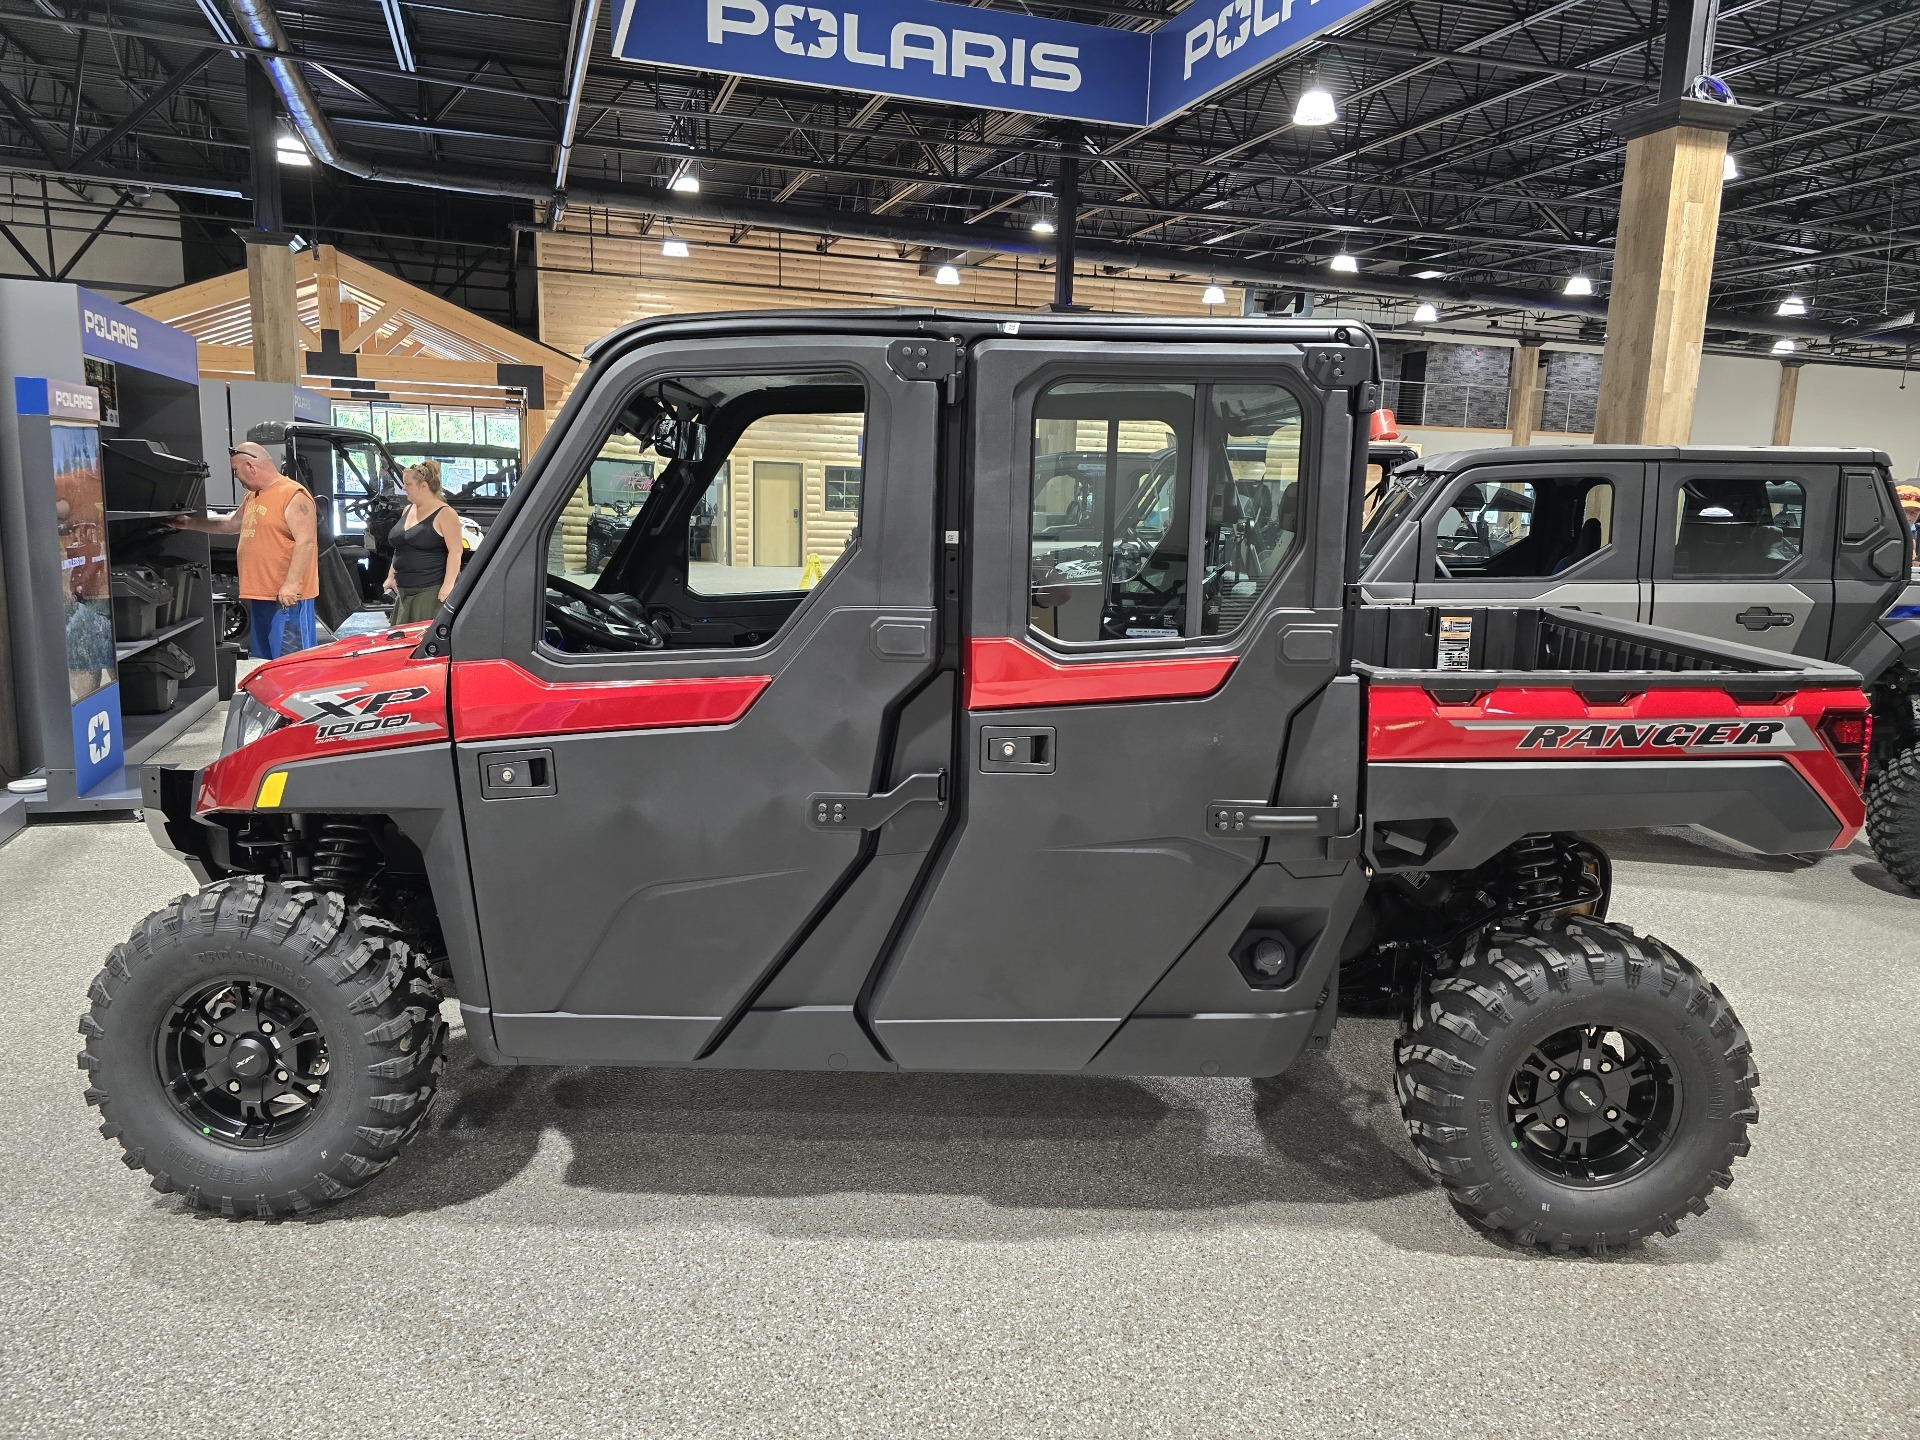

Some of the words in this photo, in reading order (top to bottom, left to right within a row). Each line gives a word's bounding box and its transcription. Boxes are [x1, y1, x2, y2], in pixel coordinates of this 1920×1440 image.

[706, 0, 1082, 92] POLARIS
[84, 309, 139, 350] POLARIS
[55, 390, 94, 410] POLARIS
[290, 685, 432, 728] XP
[315, 713, 411, 739] 1000
[315, 737, 337, 745] DUAL
[338, 730, 384, 741] OVERHEAD
[1515, 720, 1786, 749] RANGER
[194, 949, 231, 964] PRO
[236, 950, 296, 979] ARMOR
[161, 1141, 274, 1185] X-TERRAIN
